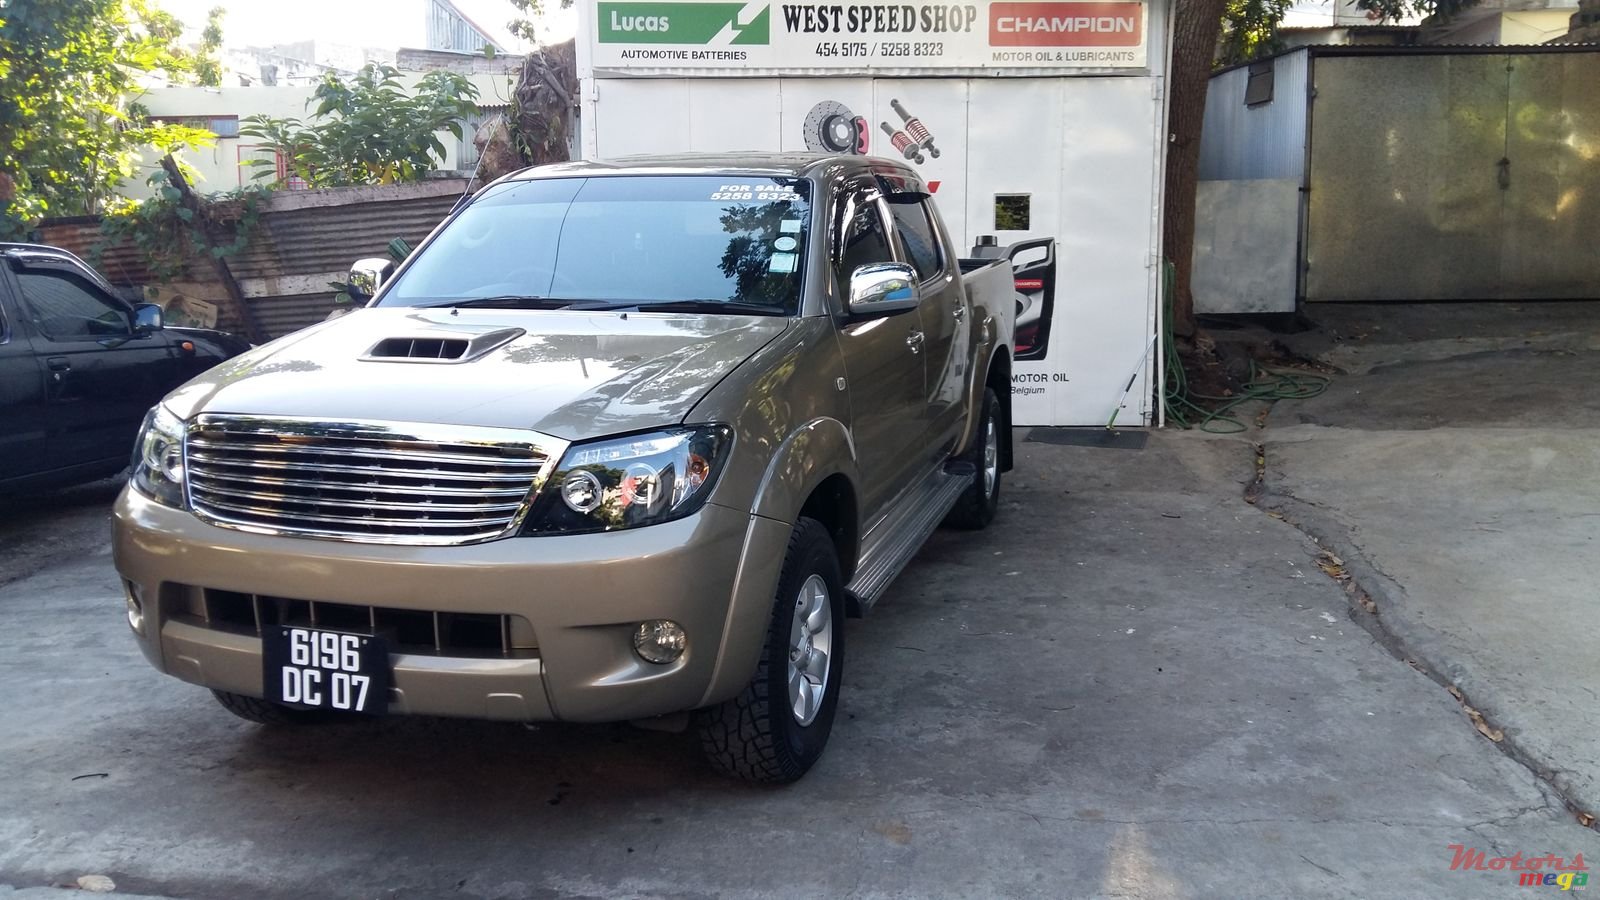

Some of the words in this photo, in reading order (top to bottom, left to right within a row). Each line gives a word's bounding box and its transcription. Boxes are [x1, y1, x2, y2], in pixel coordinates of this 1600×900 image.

[611, 11, 669, 32] Lucas
[782, 5, 843, 33] WEST
[847, 5, 917, 33] SPEED
[920, 5, 977, 33] SHOP
[997, 17, 1134, 33] CHAMPION
[621, 50, 688, 60] AUTOMOTIVE
[691, 51, 747, 60] BATTERIES
[815, 42, 838, 57] 454
[841, 42, 867, 57] 5175
[870, 43, 878, 56] /
[881, 42, 910, 57] 5258
[913, 42, 943, 56] 8323
[992, 52, 1033, 62] MOTOR
[1035, 52, 1053, 61] OIL
[1055, 52, 1063, 61] &
[1065, 52, 1135, 61] LUBRICANTS
[710, 192, 753, 200] 5258
[757, 192, 801, 201] 8323
[1011, 374, 1048, 383] MOTOR
[1052, 373, 1070, 382] OIL
[1011, 386, 1045, 396] Belgium
[291, 629, 360, 672] 6196
[282, 666, 321, 706] DC
[331, 672, 370, 711] 07
